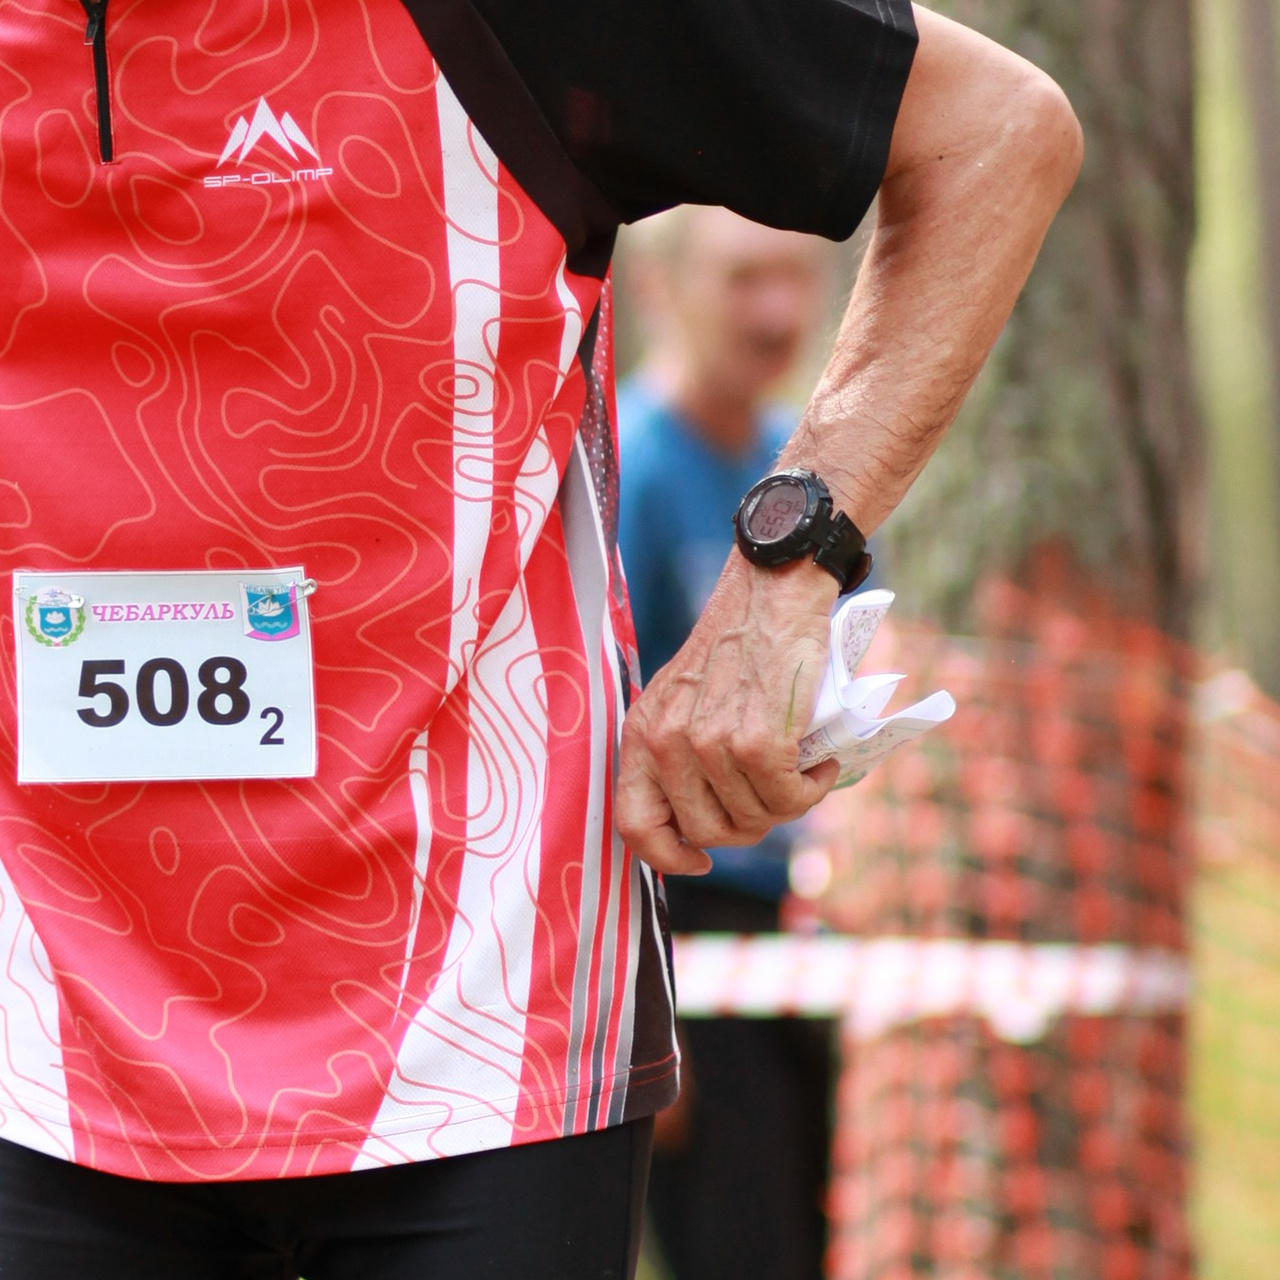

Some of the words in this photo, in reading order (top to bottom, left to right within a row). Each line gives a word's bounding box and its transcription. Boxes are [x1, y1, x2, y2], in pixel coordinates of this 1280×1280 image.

[203, 167, 333, 188] SP-OLIMP
[91, 601, 235, 622] ЧЕБАРКУЛЬ
[76, 656, 251, 728] 508
[259, 706, 285, 745] 2
